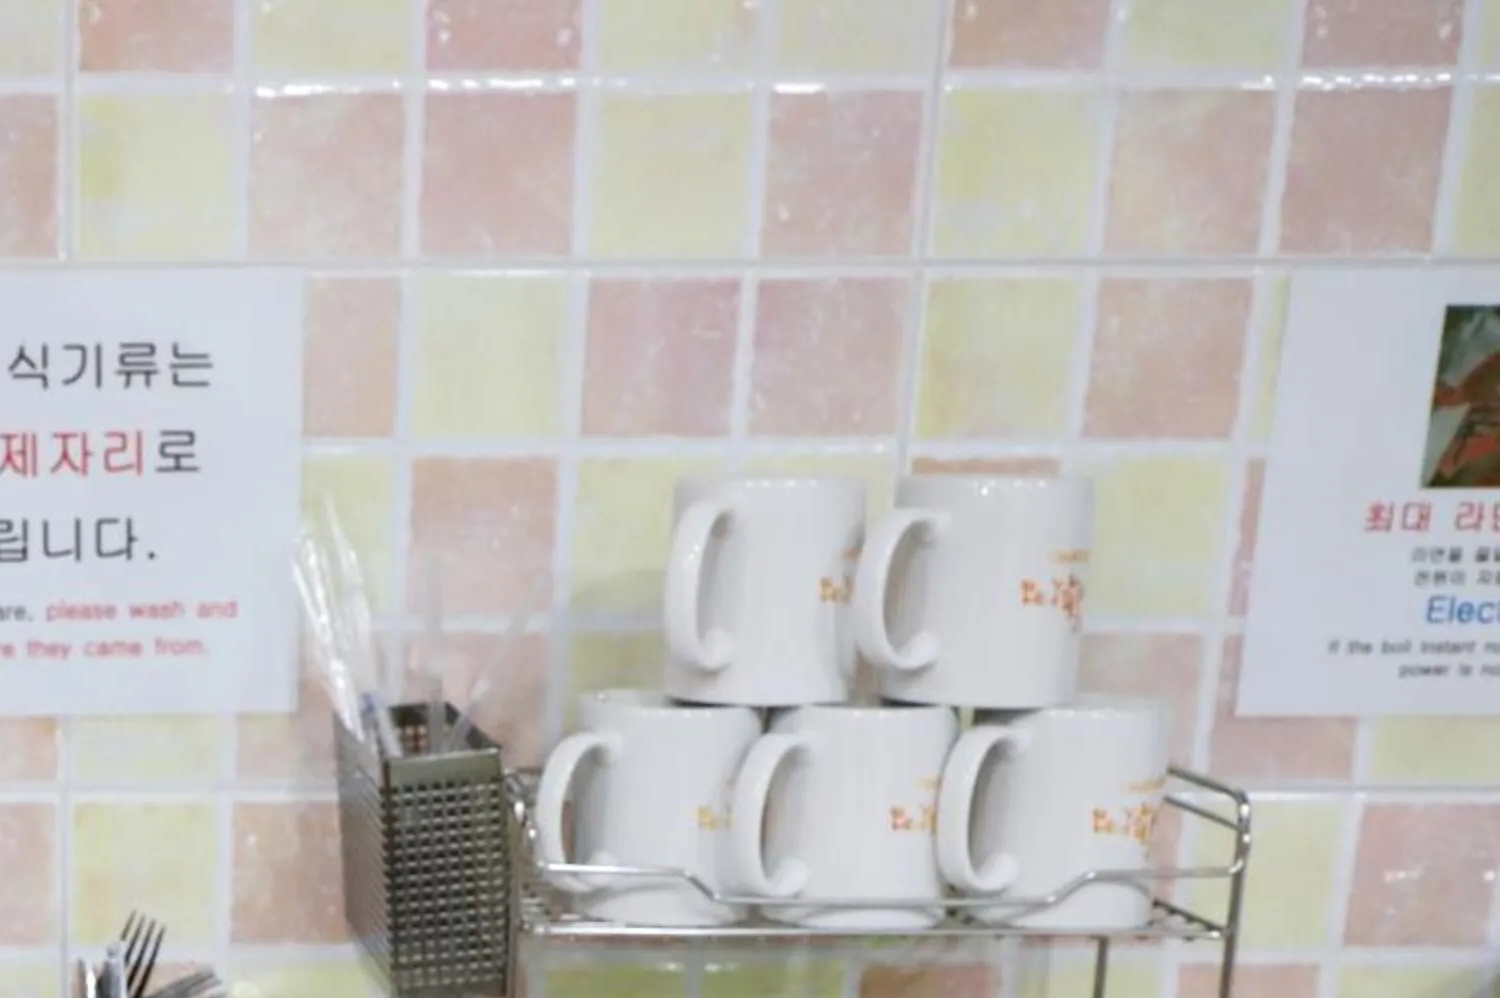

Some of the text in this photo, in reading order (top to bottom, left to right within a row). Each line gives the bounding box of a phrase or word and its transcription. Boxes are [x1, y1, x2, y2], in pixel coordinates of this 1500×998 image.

[6, 341, 215, 390] 식기류는
[1364, 501, 1500, 532] 최대 라
[45, 602, 118, 622] please
[129, 602, 185, 621] wash
[197, 601, 238, 619] and
[27, 640, 72, 661] they
[83, 640, 144, 658] came
